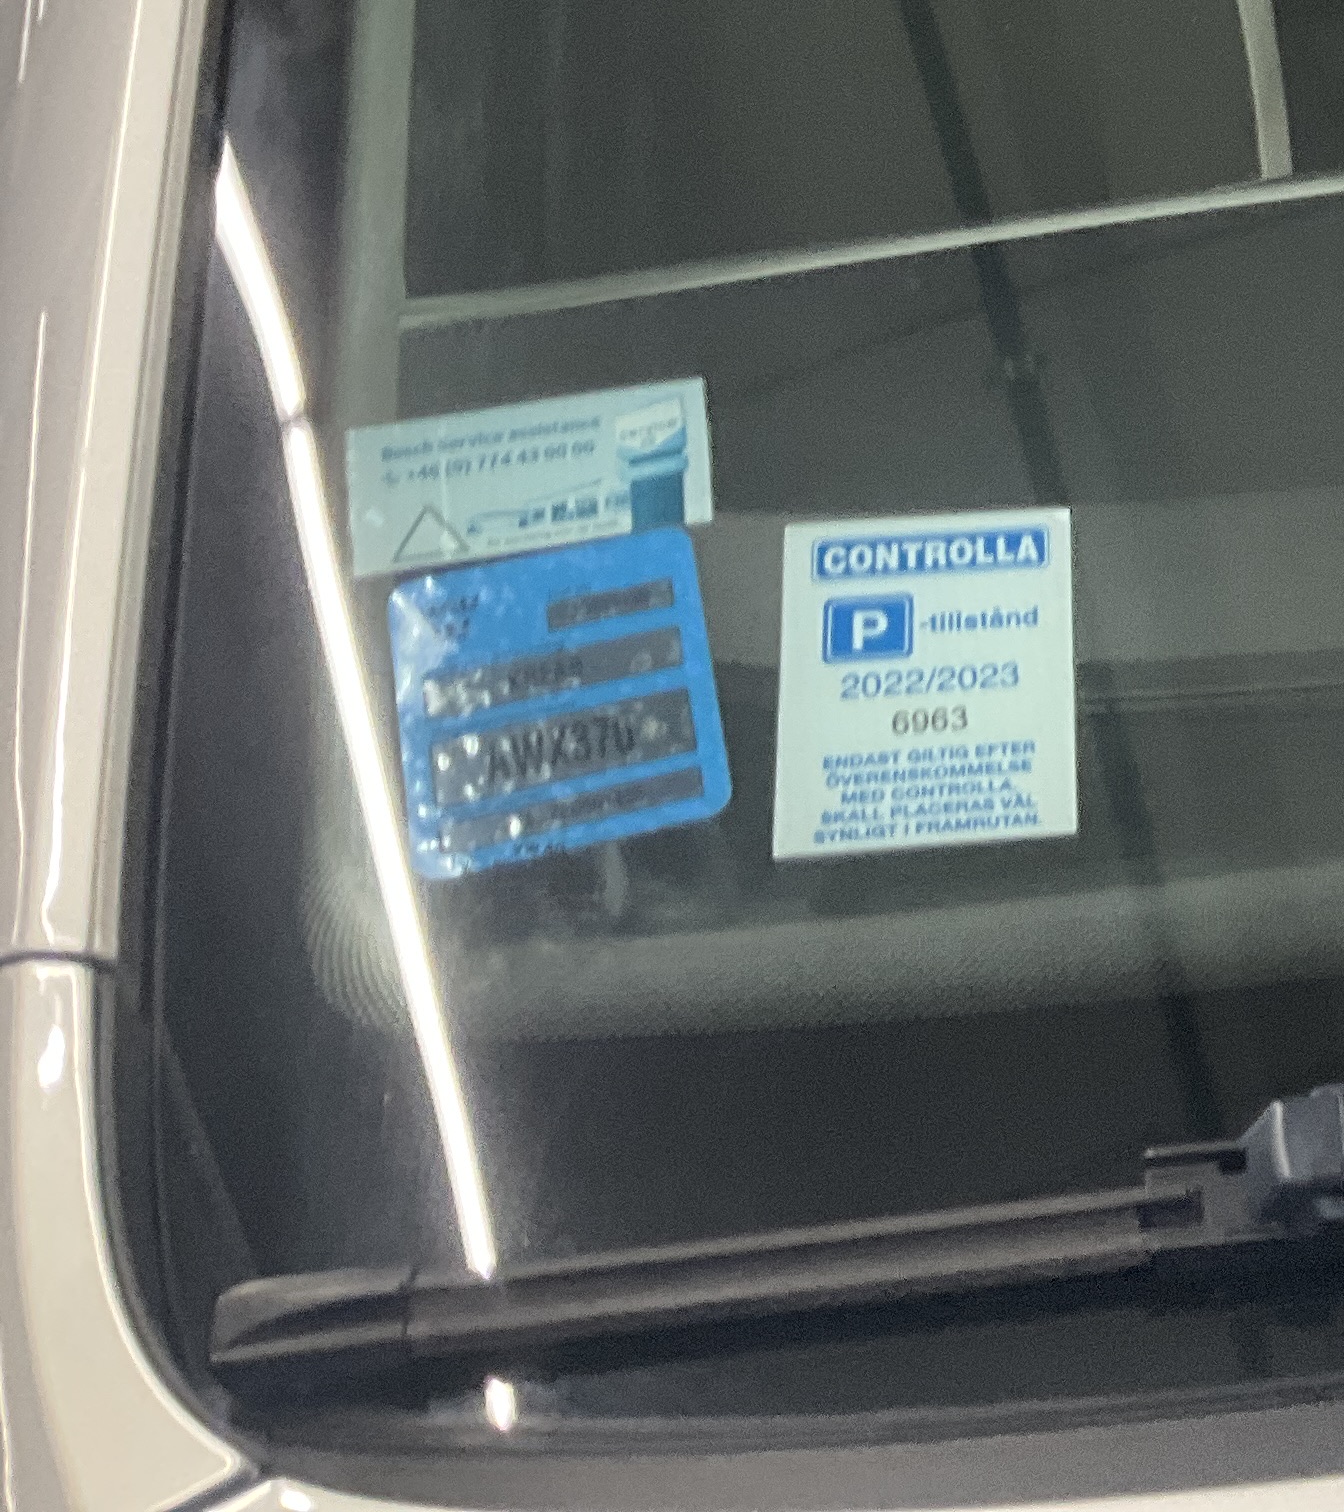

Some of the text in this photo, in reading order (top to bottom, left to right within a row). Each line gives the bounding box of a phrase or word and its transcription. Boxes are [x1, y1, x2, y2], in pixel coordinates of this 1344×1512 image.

[824, 535, 1039, 574] CONTROLLA
[853, 608, 888, 651] P
[840, 661, 1020, 701] 2022/2023
[822, 738, 1036, 770] ENDAST GILTIG EFTER
[821, 807, 885, 825] SKALL
[890, 797, 995, 820] PLACERAS
[841, 788, 885, 805] MED
[814, 822, 897, 845] SYNLIGT
